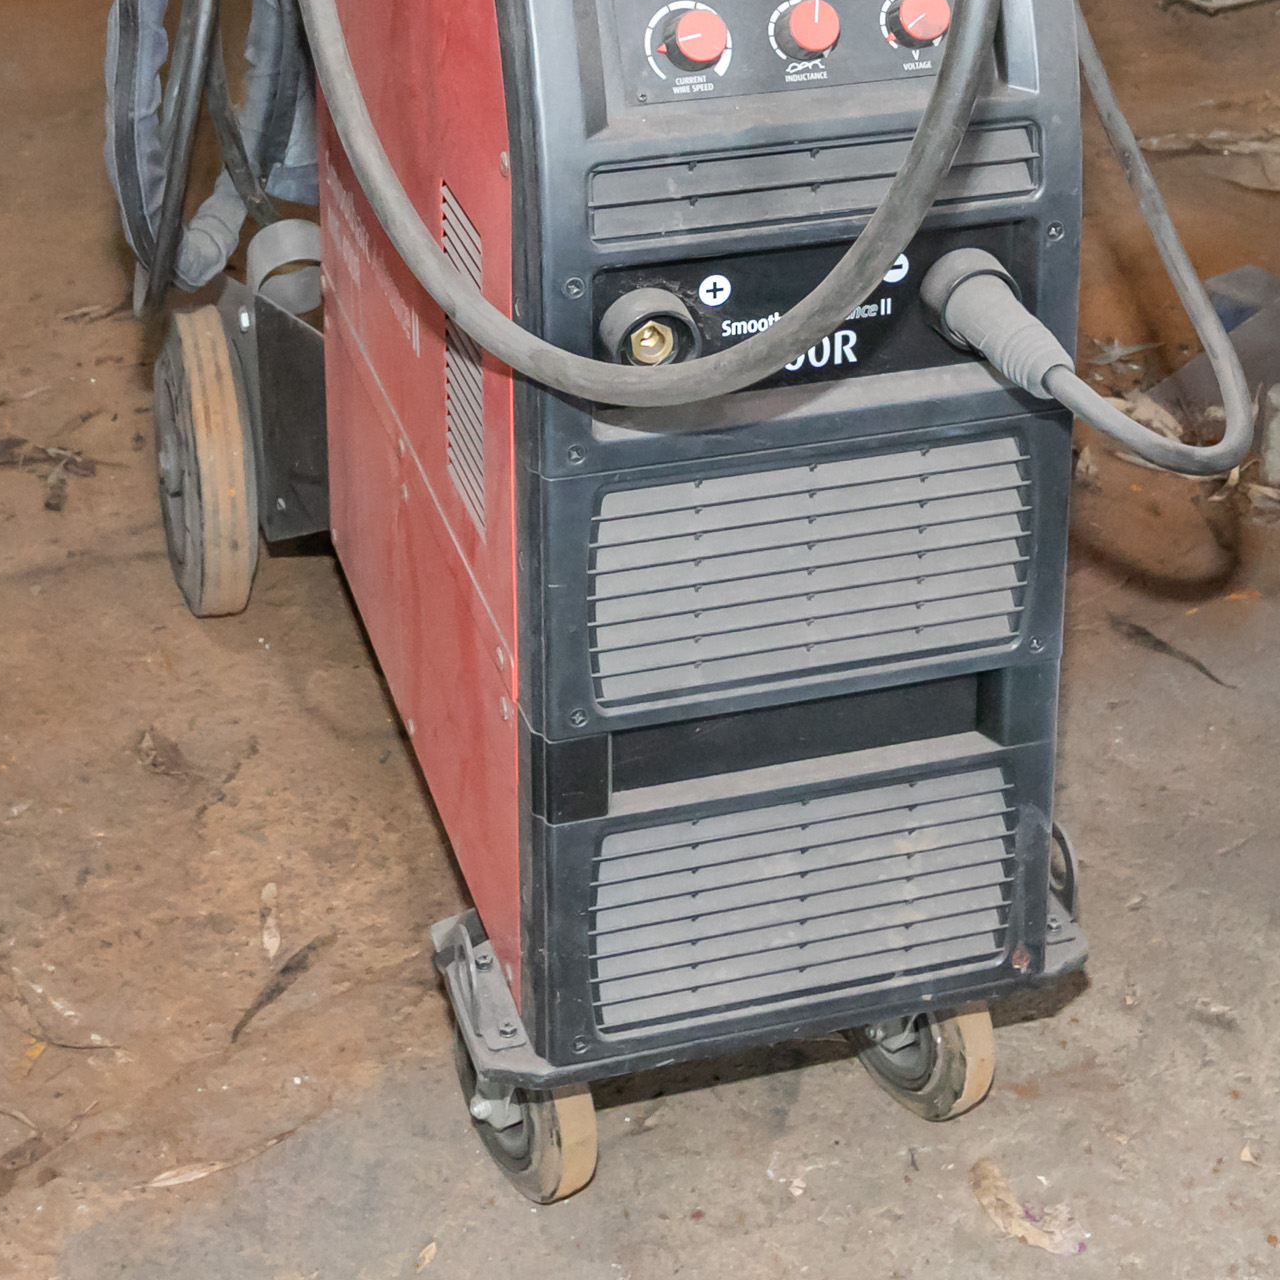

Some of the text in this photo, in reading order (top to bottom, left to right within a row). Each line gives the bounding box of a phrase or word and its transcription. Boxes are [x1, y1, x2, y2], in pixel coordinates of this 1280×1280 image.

[911, 50, 920, 60] V
[903, 61, 932, 71] VOLTAGE
[675, 75, 707, 86] CURRENT
[785, 72, 828, 83] INDUCTANCE
[672, 83, 715, 95] WIRE SPEED
[721, 311, 782, 337] Smoot
